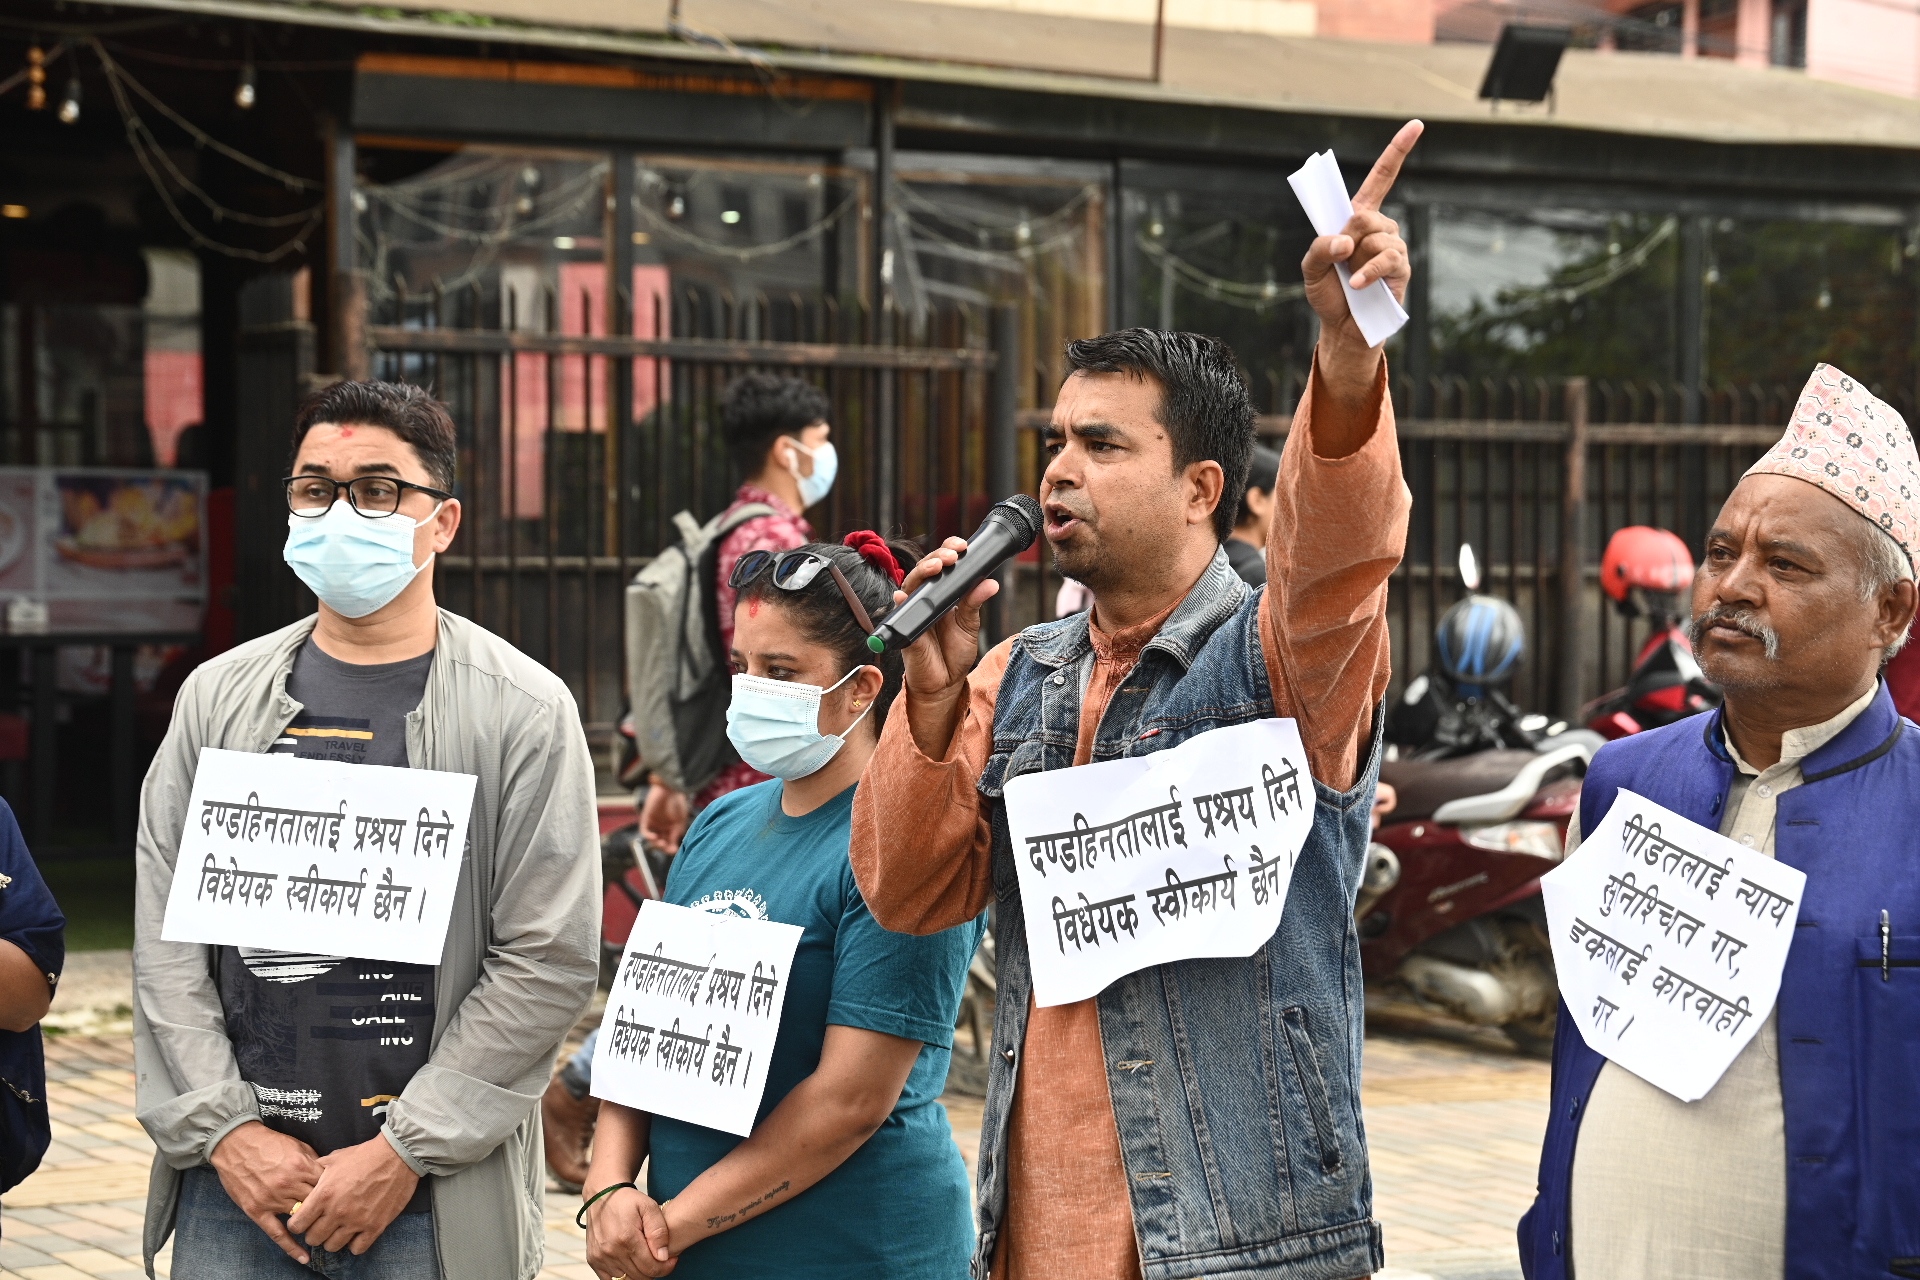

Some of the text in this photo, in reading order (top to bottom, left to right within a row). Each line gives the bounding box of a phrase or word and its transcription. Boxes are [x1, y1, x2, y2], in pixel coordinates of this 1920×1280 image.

[324, 740, 367, 753] TRAVEL
[202, 791, 455, 860] दण्डहिनतालाई प्रश्रय दिने
[1025, 757, 1303, 878] दण्डहिनतालाई प्रश्रय दिने
[198, 852, 279, 909] विधेयक
[286, 863, 369, 917] स्वीकार्य
[373, 866, 413, 923] छैन
[1052, 891, 1139, 956] विधेयक
[1146, 853, 1238, 927] स्वीकार्य
[1248, 844, 1280, 905] छैन
[1621, 813, 1795, 929] पीडितलाई न्याय
[1599, 871, 1706, 949] सुनिश्चित
[705, 967, 747, 1011] प्रश्रय
[747, 960, 779, 1020] दिने
[1592, 995, 1620, 1032] गर
[1652, 965, 1753, 1037] कारवाही
[608, 1004, 656, 1066] विधेयक
[656, 1017, 713, 1078] स्वीकार्य
[711, 1023, 743, 1087] छैन
